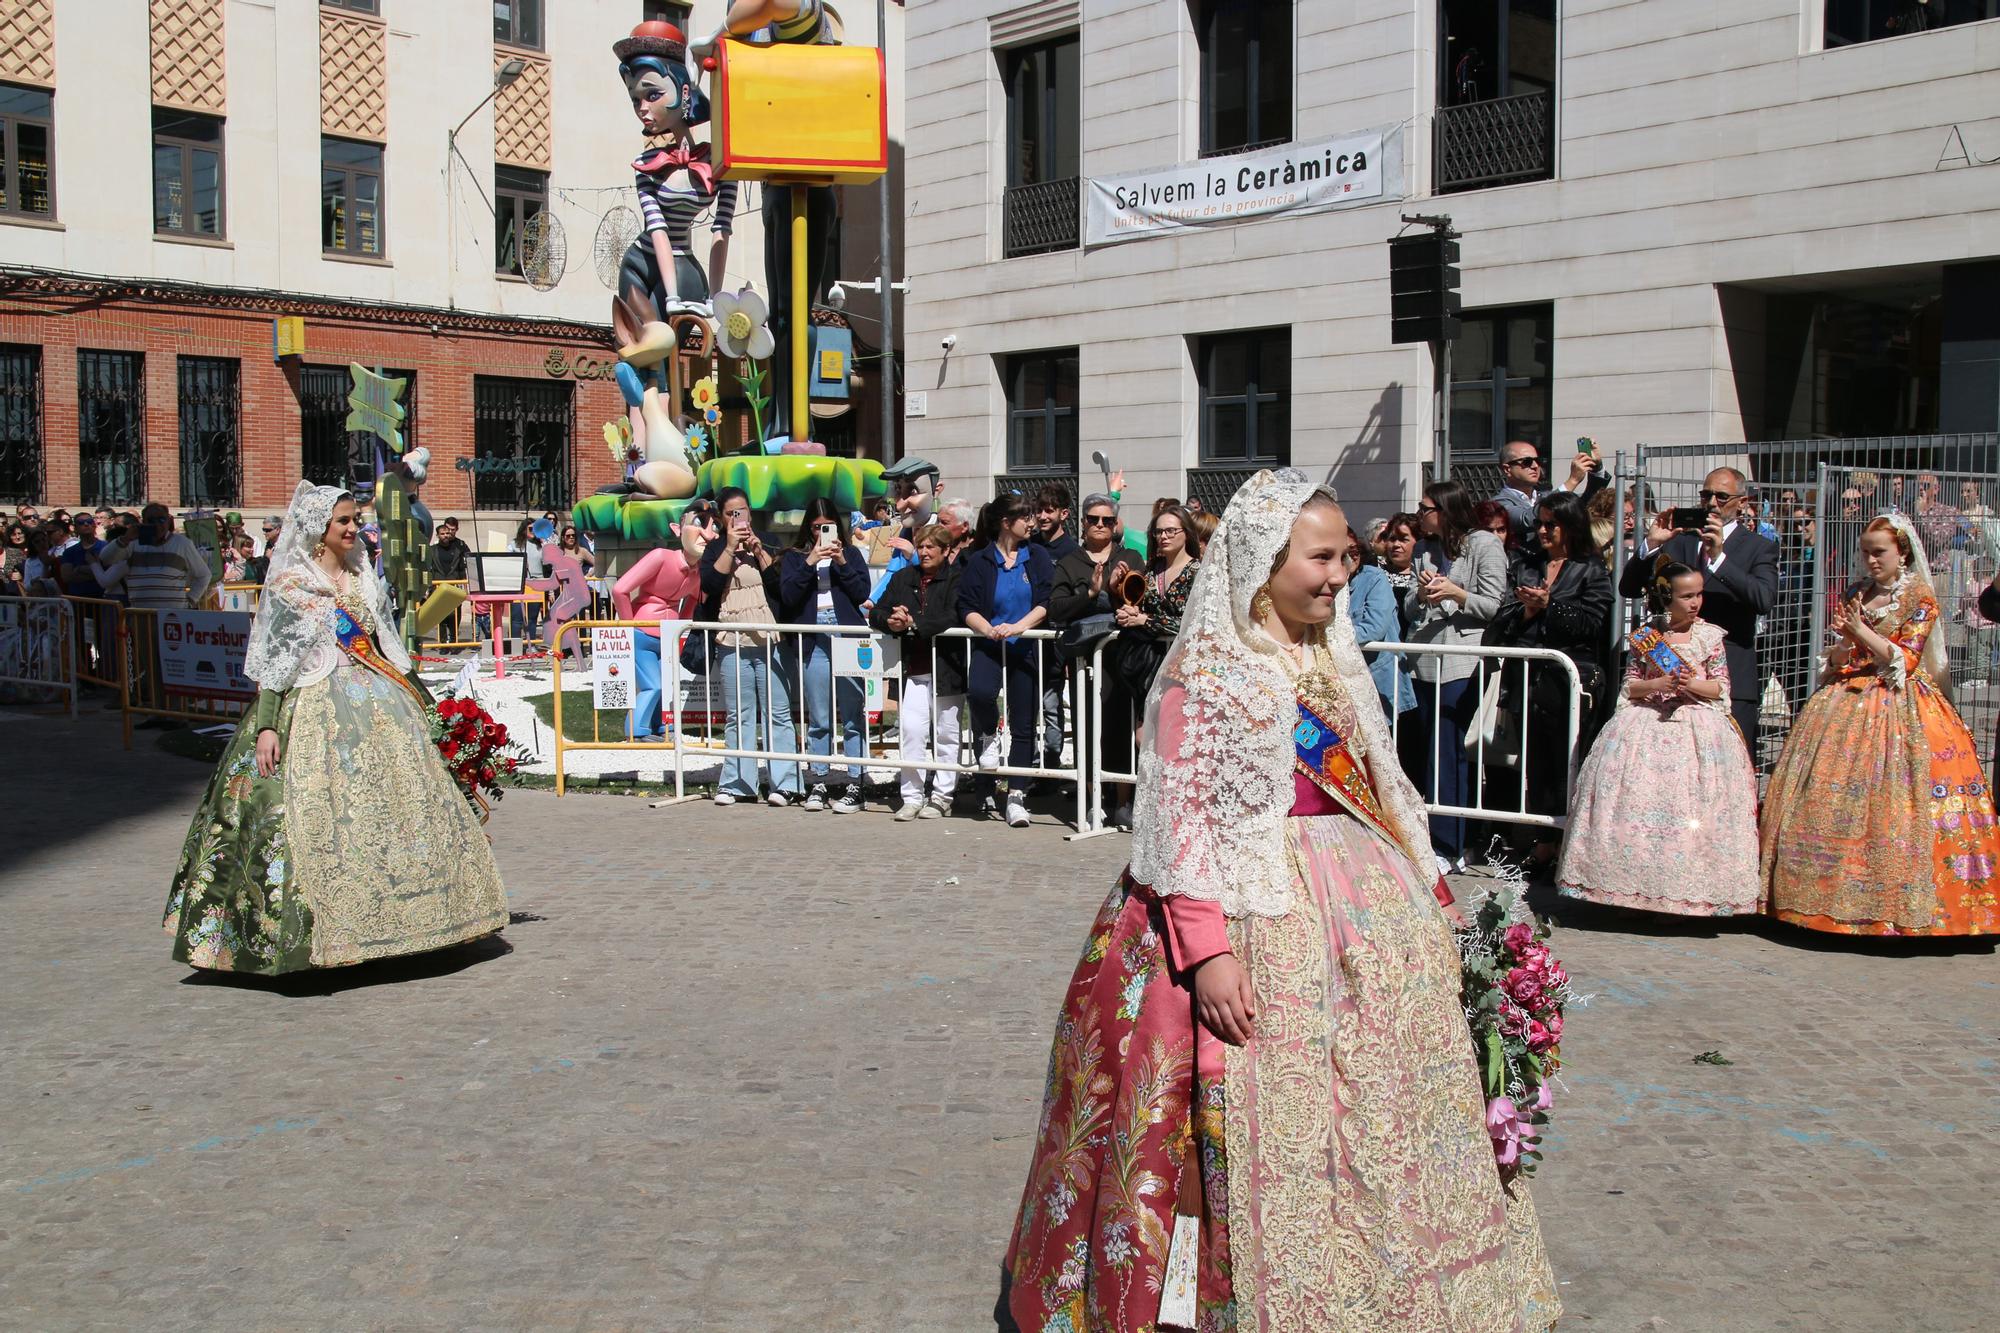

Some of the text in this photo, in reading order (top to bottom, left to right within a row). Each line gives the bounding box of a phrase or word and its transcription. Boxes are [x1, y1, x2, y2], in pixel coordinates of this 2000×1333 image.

[1115, 181, 1195, 210] Salvem
[1206, 173, 1226, 197] la
[1237, 149, 1367, 193] Ceràmica
[1114, 215, 1144, 228] Units
[1167, 207, 1199, 220] futur
[1203, 204, 1217, 216] de
[1221, 202, 1232, 213] la
[167, 622, 247, 647] Pb Persibur
[596, 641, 631, 651] LA VILA
[599, 629, 627, 639] FALLA
